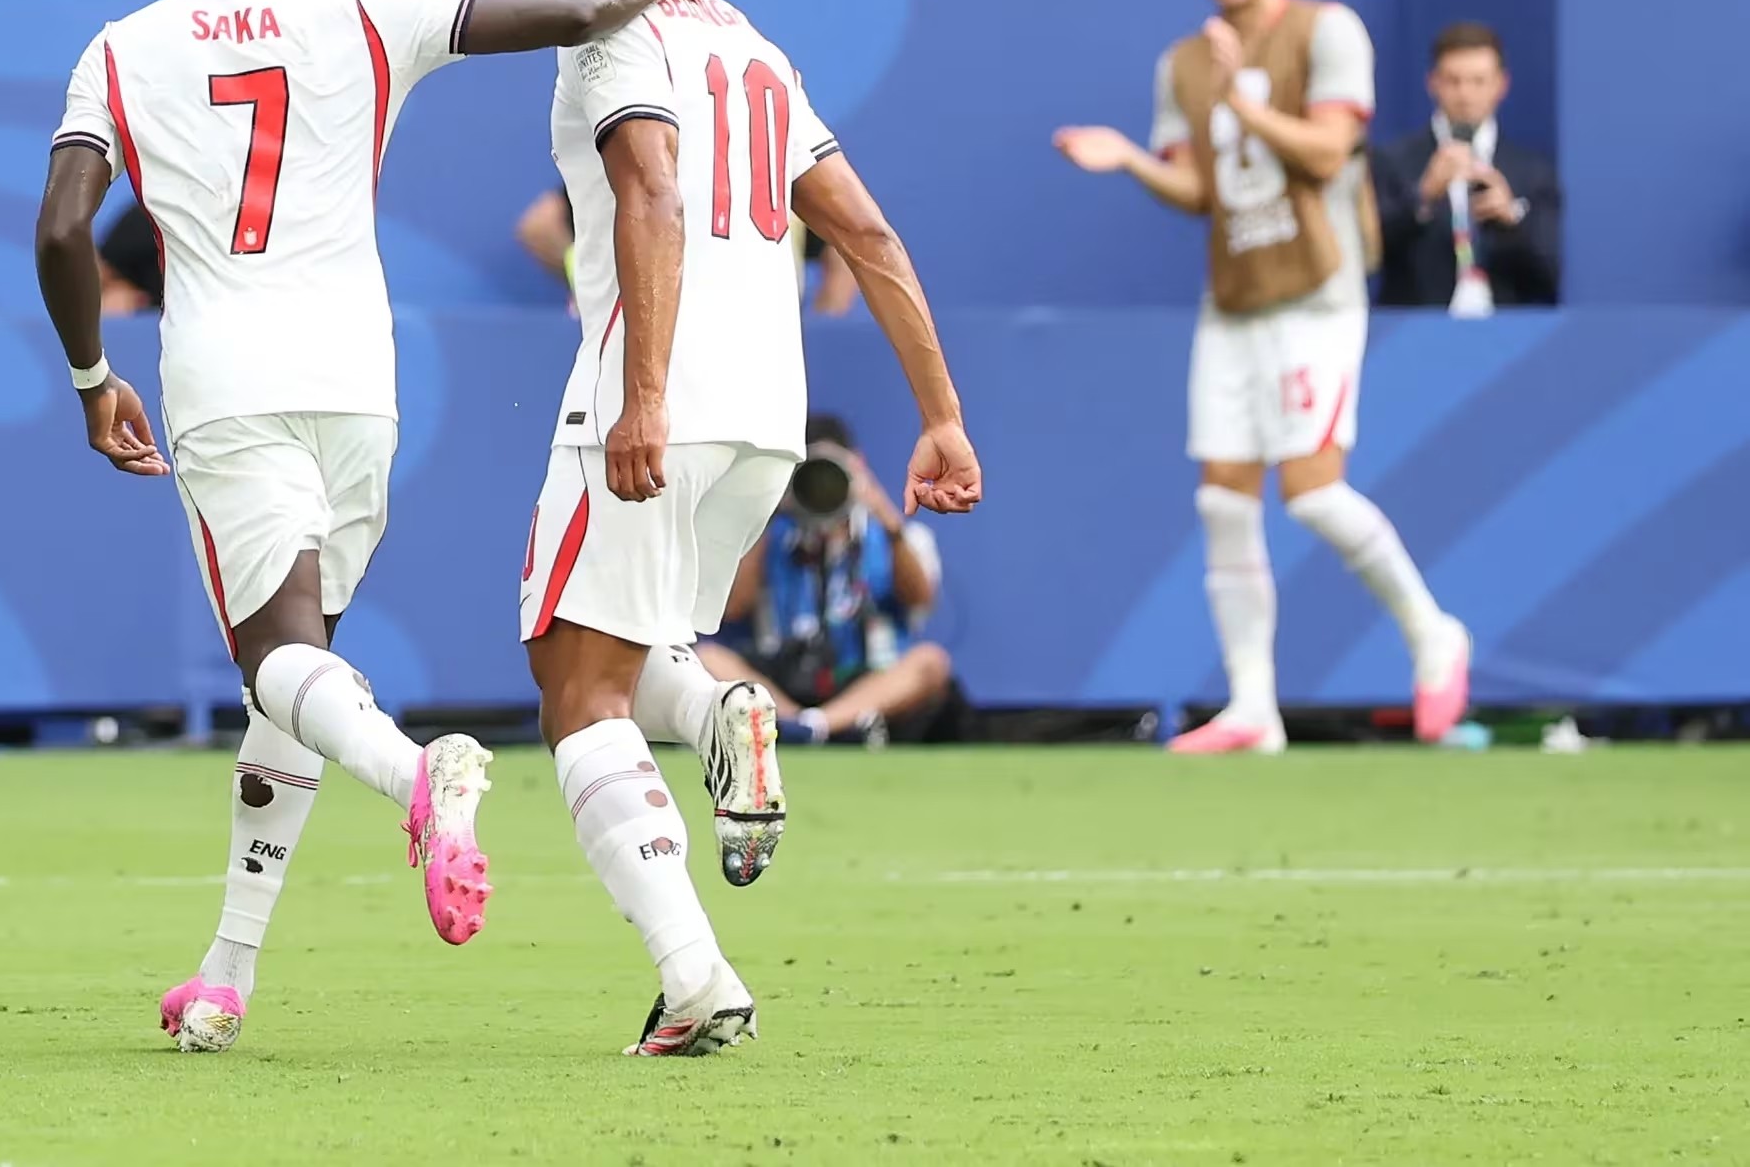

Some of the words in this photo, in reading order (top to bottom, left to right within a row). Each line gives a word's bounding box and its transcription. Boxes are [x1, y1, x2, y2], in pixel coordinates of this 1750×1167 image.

[191, 7, 282, 44] SAKA
[208, 66, 290, 254] 7
[704, 53, 790, 243] 10
[249, 839, 287, 861] ENG
